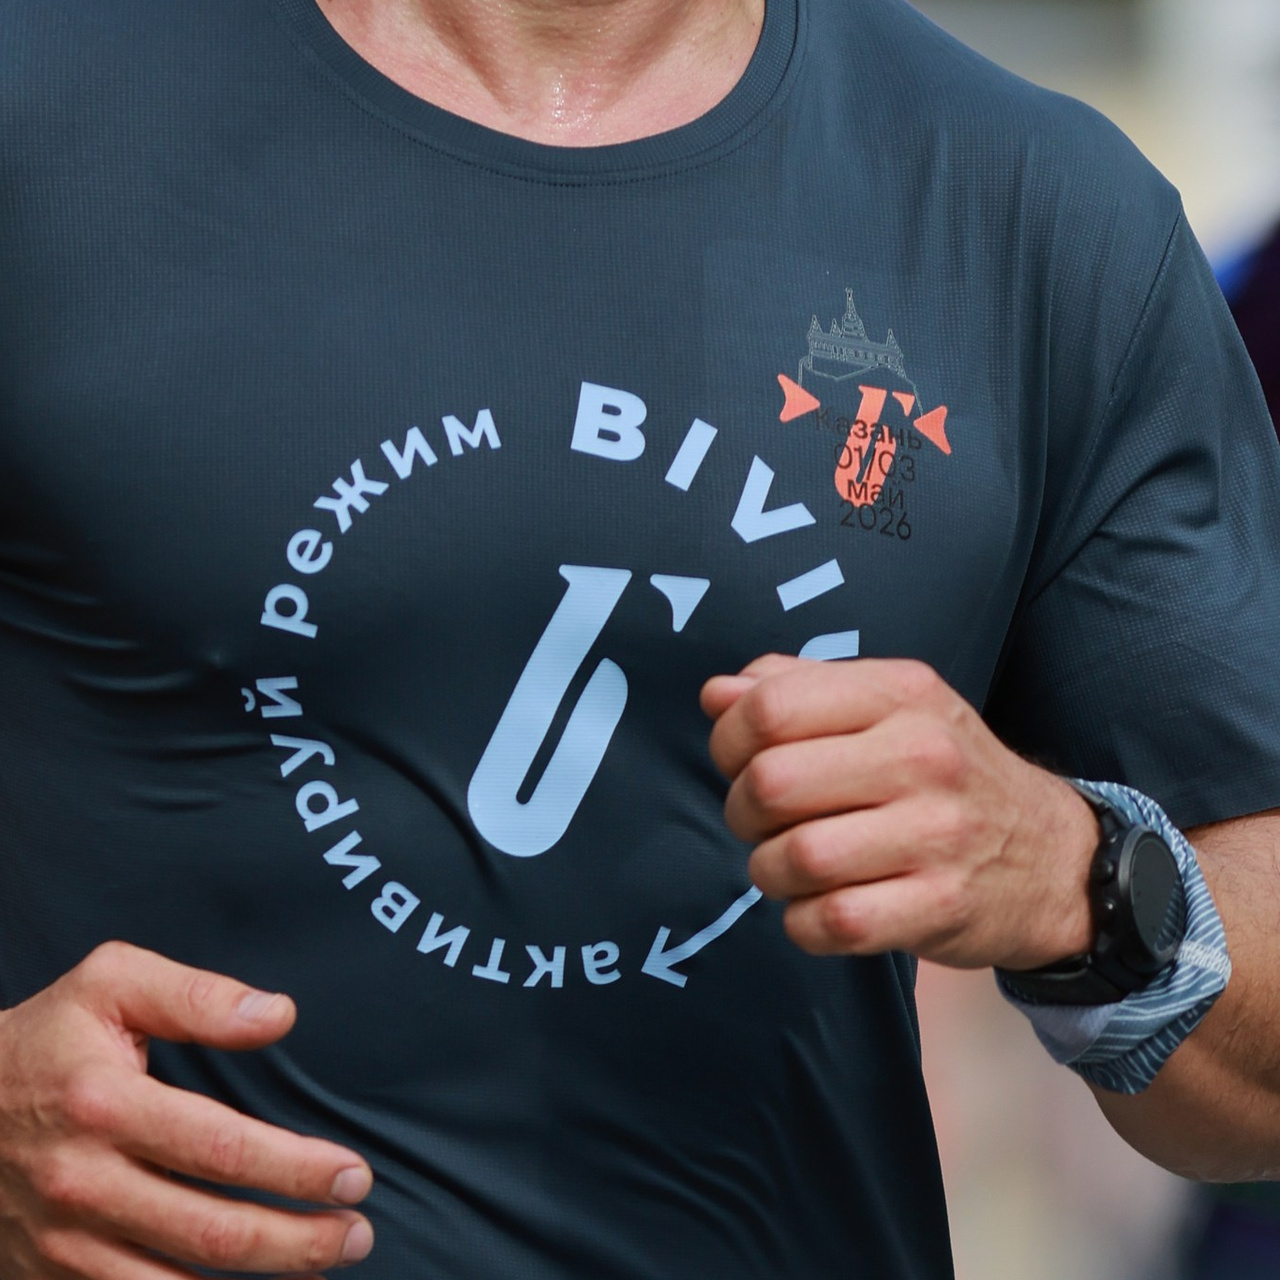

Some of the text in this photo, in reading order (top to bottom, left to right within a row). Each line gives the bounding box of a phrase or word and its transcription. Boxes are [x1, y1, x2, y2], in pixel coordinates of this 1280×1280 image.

[814, 410, 922, 450] Казань
[834, 443, 916, 483] 01/03
[571, 381, 860, 661] BIVI
[840, 502, 911, 540] 2026
[242, 408, 621, 988] активируй режим
